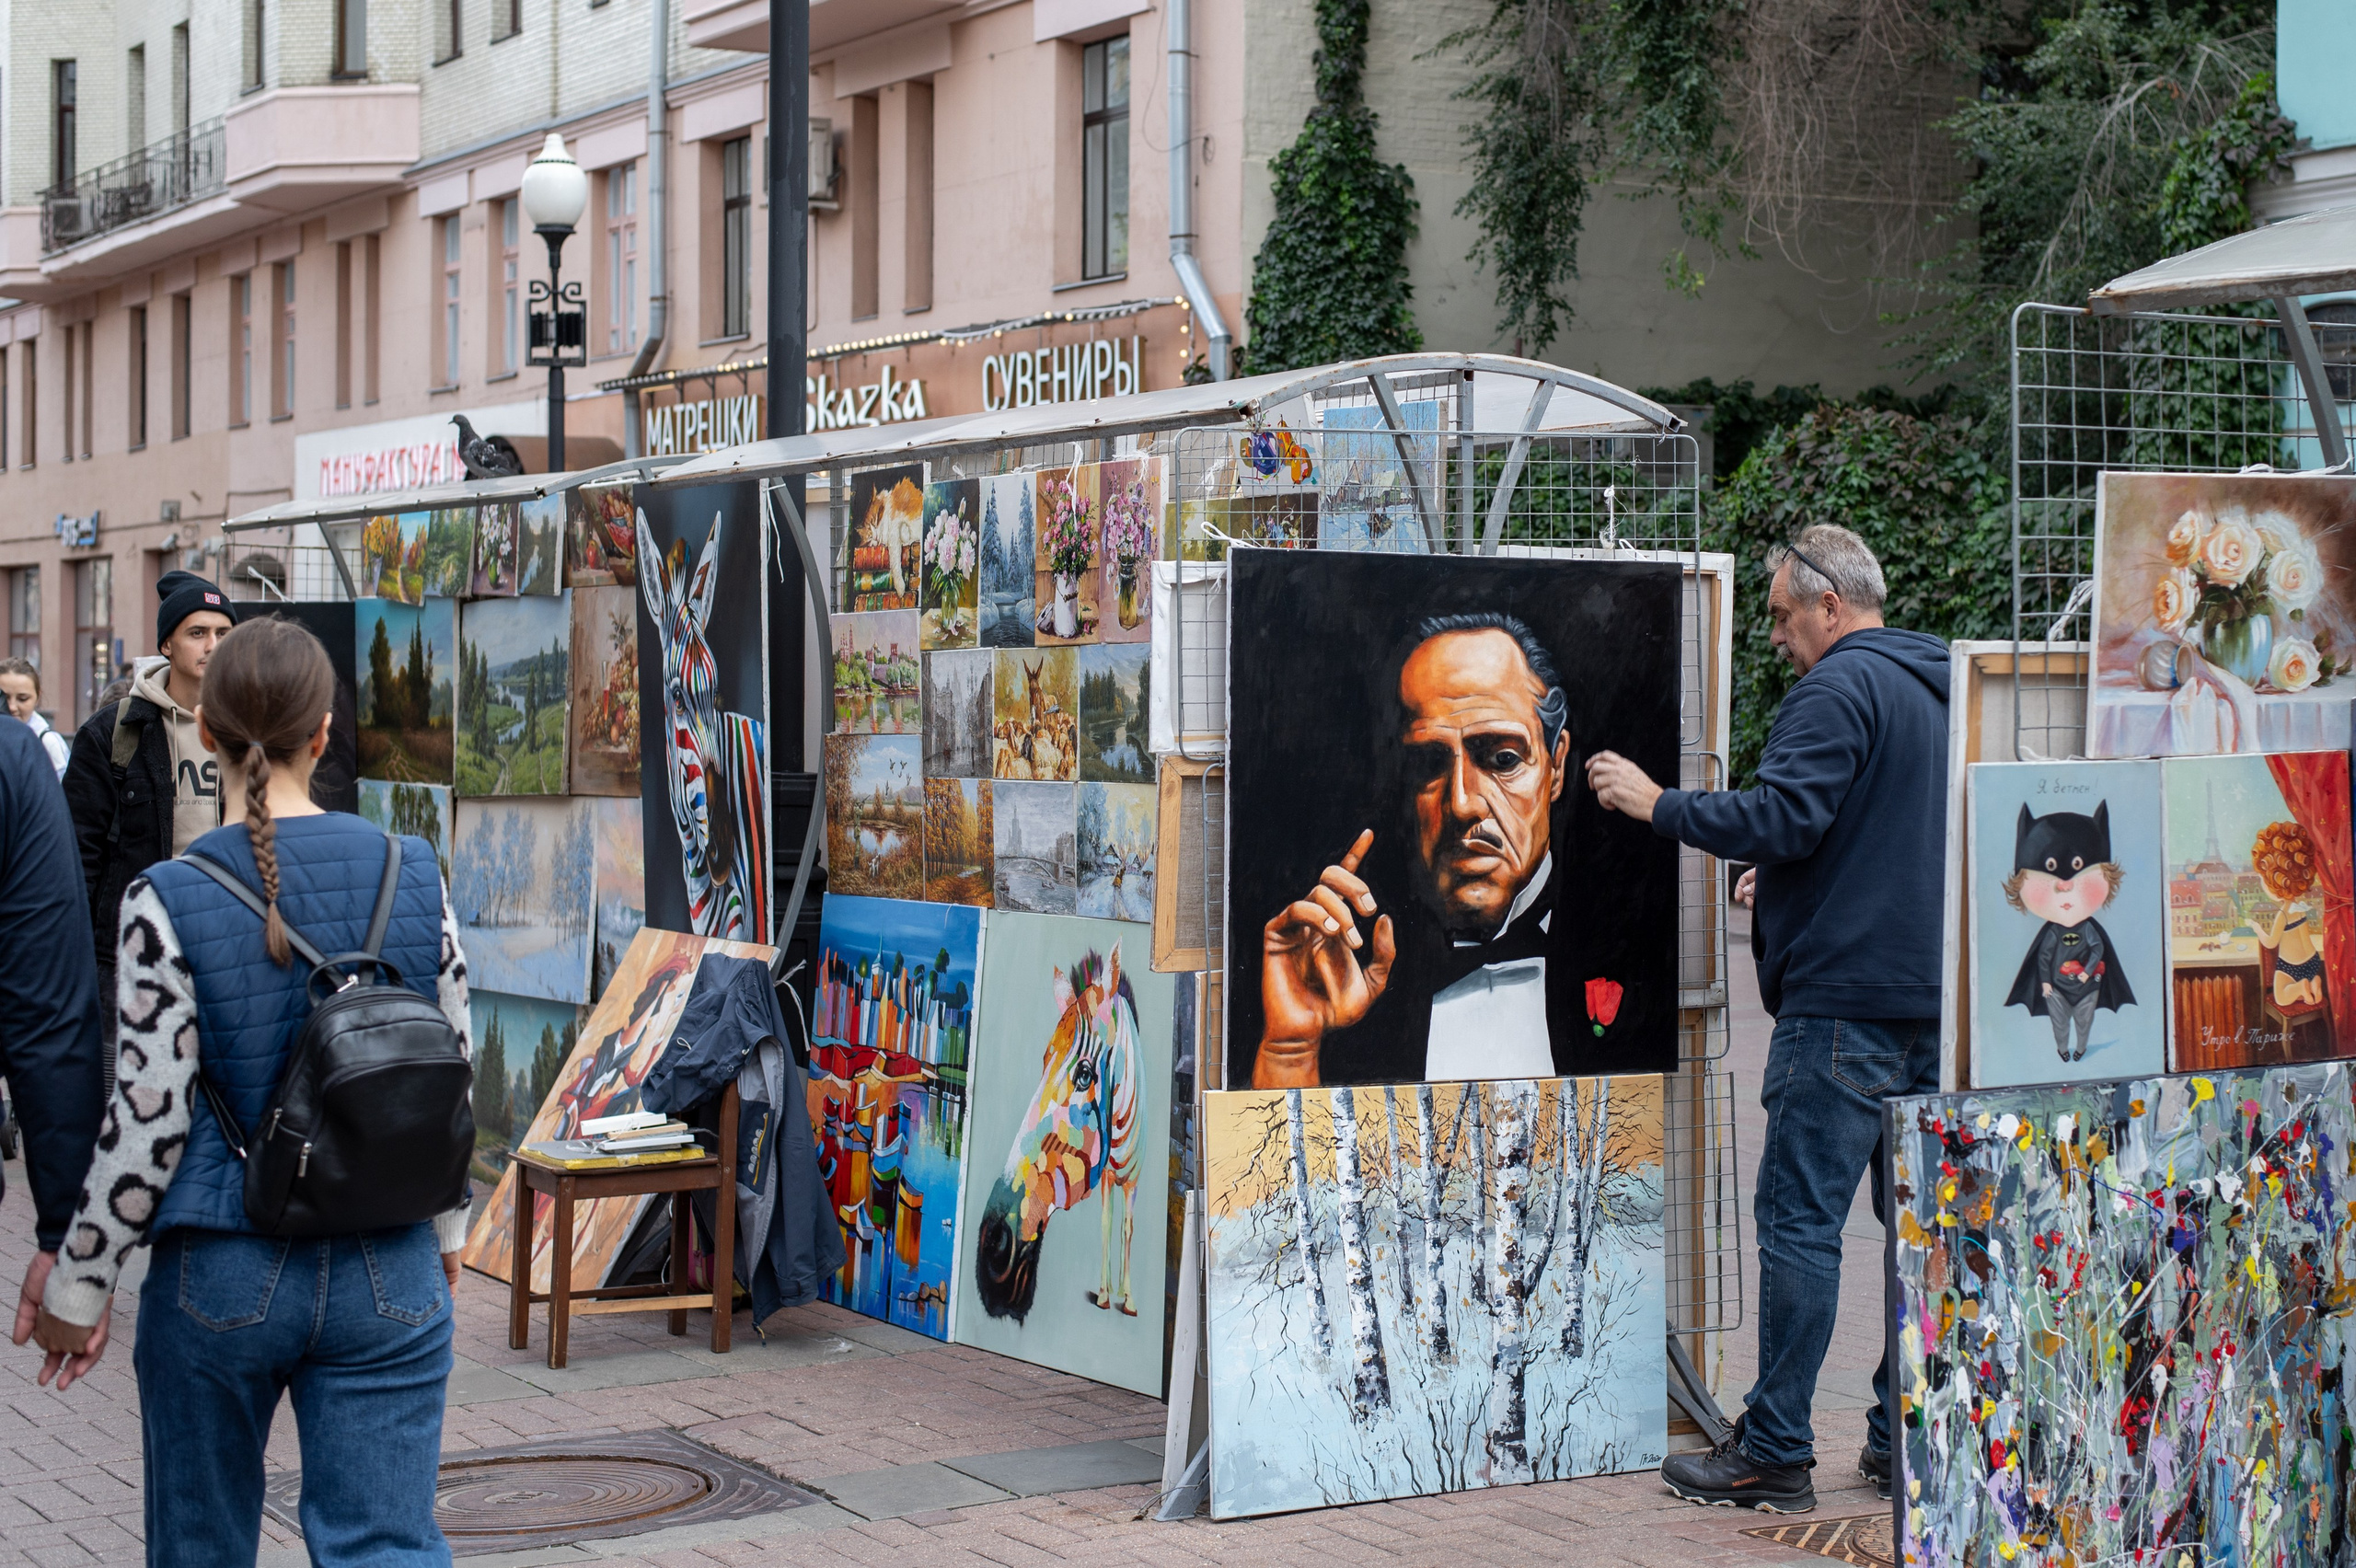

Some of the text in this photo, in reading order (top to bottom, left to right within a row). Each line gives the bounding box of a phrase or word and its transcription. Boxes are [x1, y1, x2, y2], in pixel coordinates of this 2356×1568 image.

[982, 334, 1139, 412] СУВЕНИРЫ
[646, 394, 757, 456] МАТРЕШКИ
[172, 759, 218, 796] AS
[2037, 778, 2047, 794] Я
[2201, 1025, 2296, 1051] Утро в Париже
